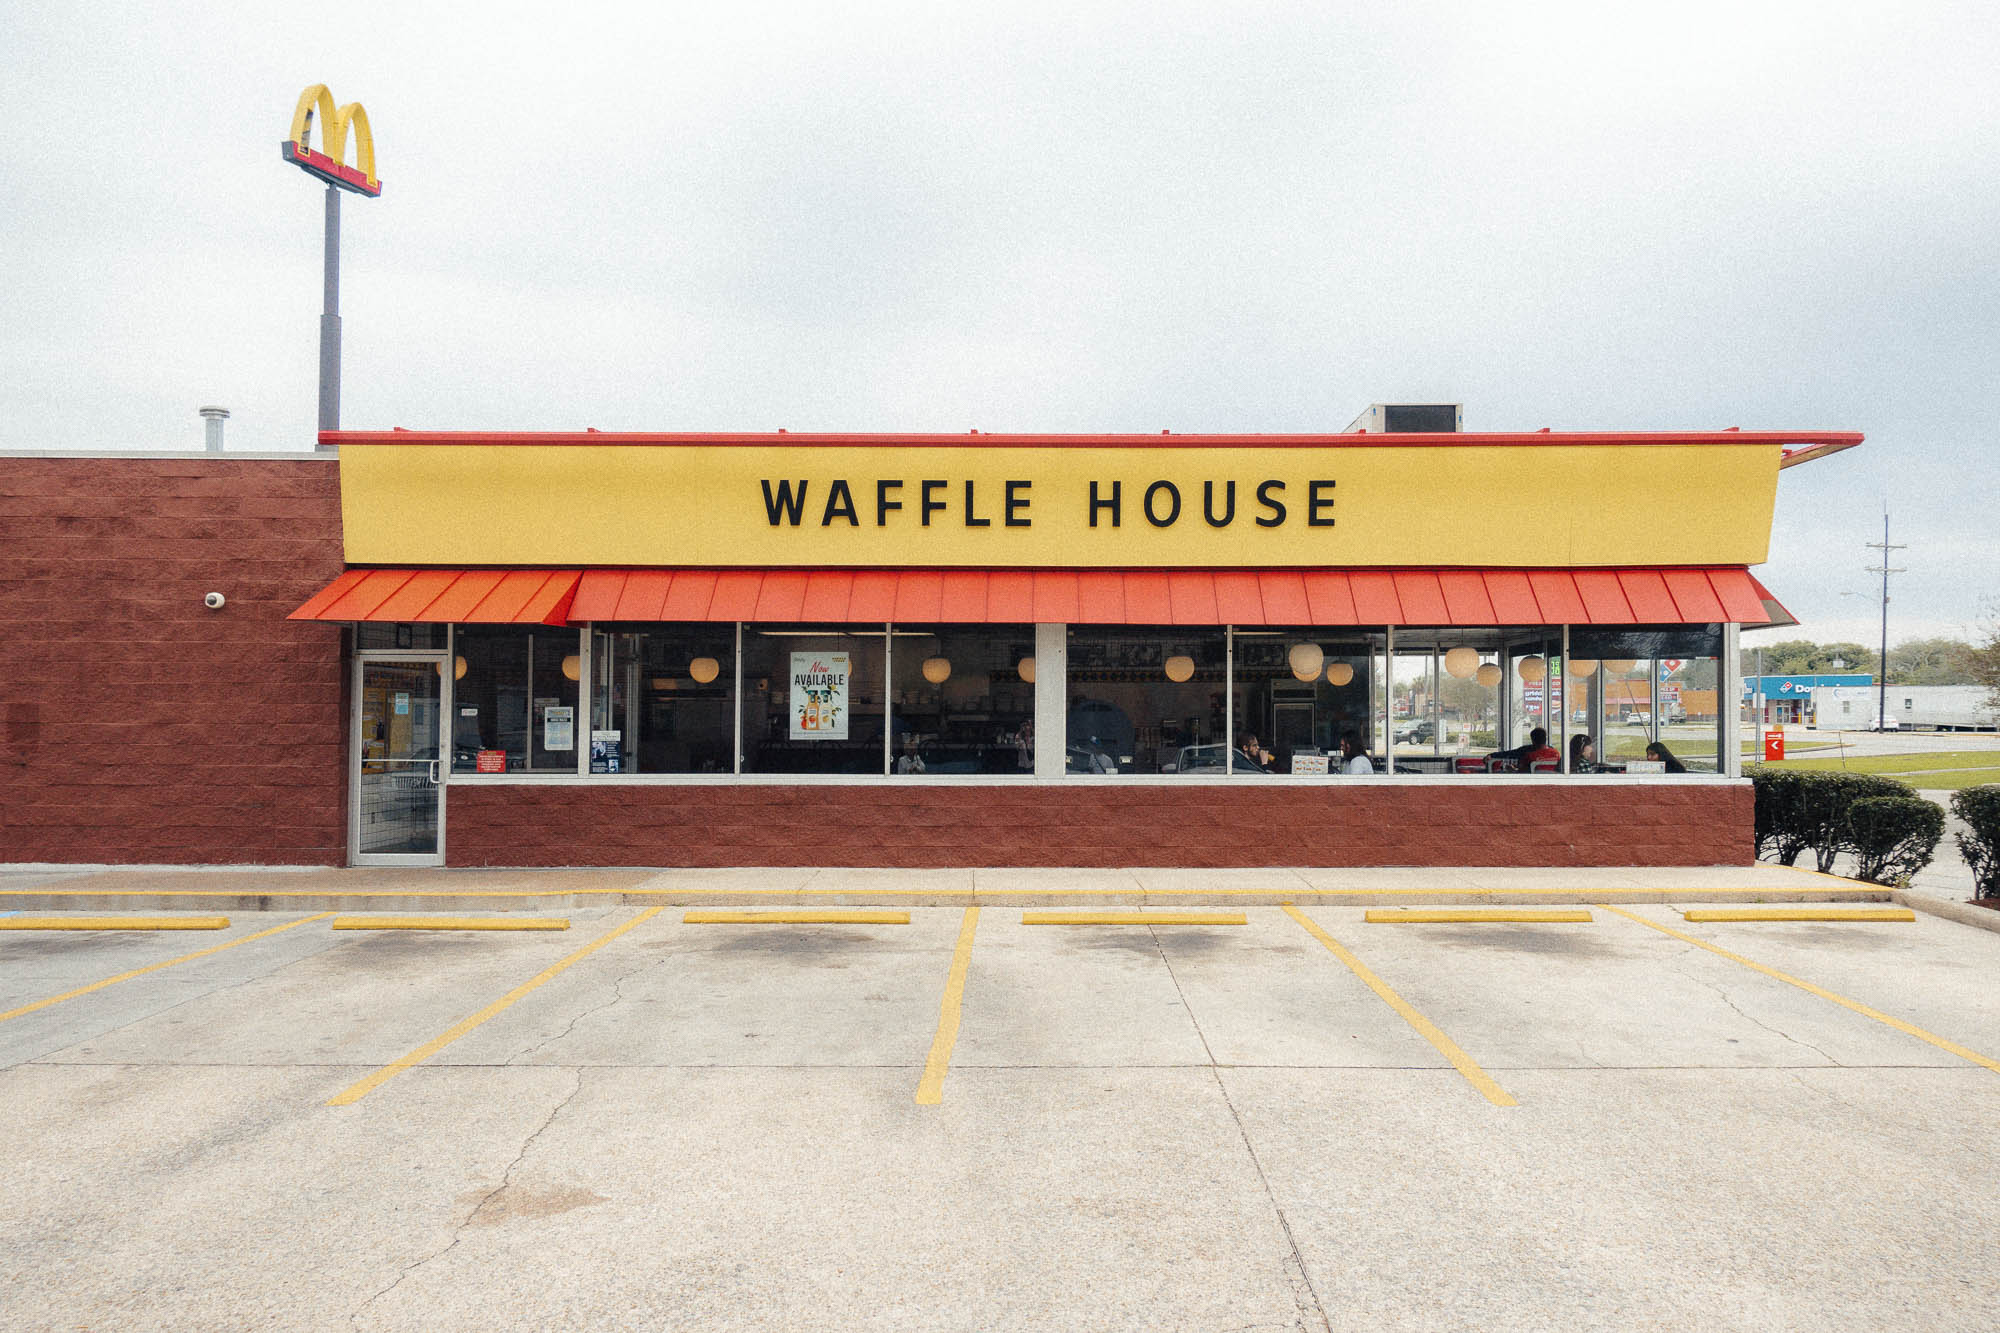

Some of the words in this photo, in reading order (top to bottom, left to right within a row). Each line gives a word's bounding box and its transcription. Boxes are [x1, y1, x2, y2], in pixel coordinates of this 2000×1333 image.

[761, 480, 1033, 527] WAFFLE
[1090, 480, 1336, 528] HOUSE
[809, 661, 830, 673] Now
[795, 674, 845, 686] AVAILABLE
